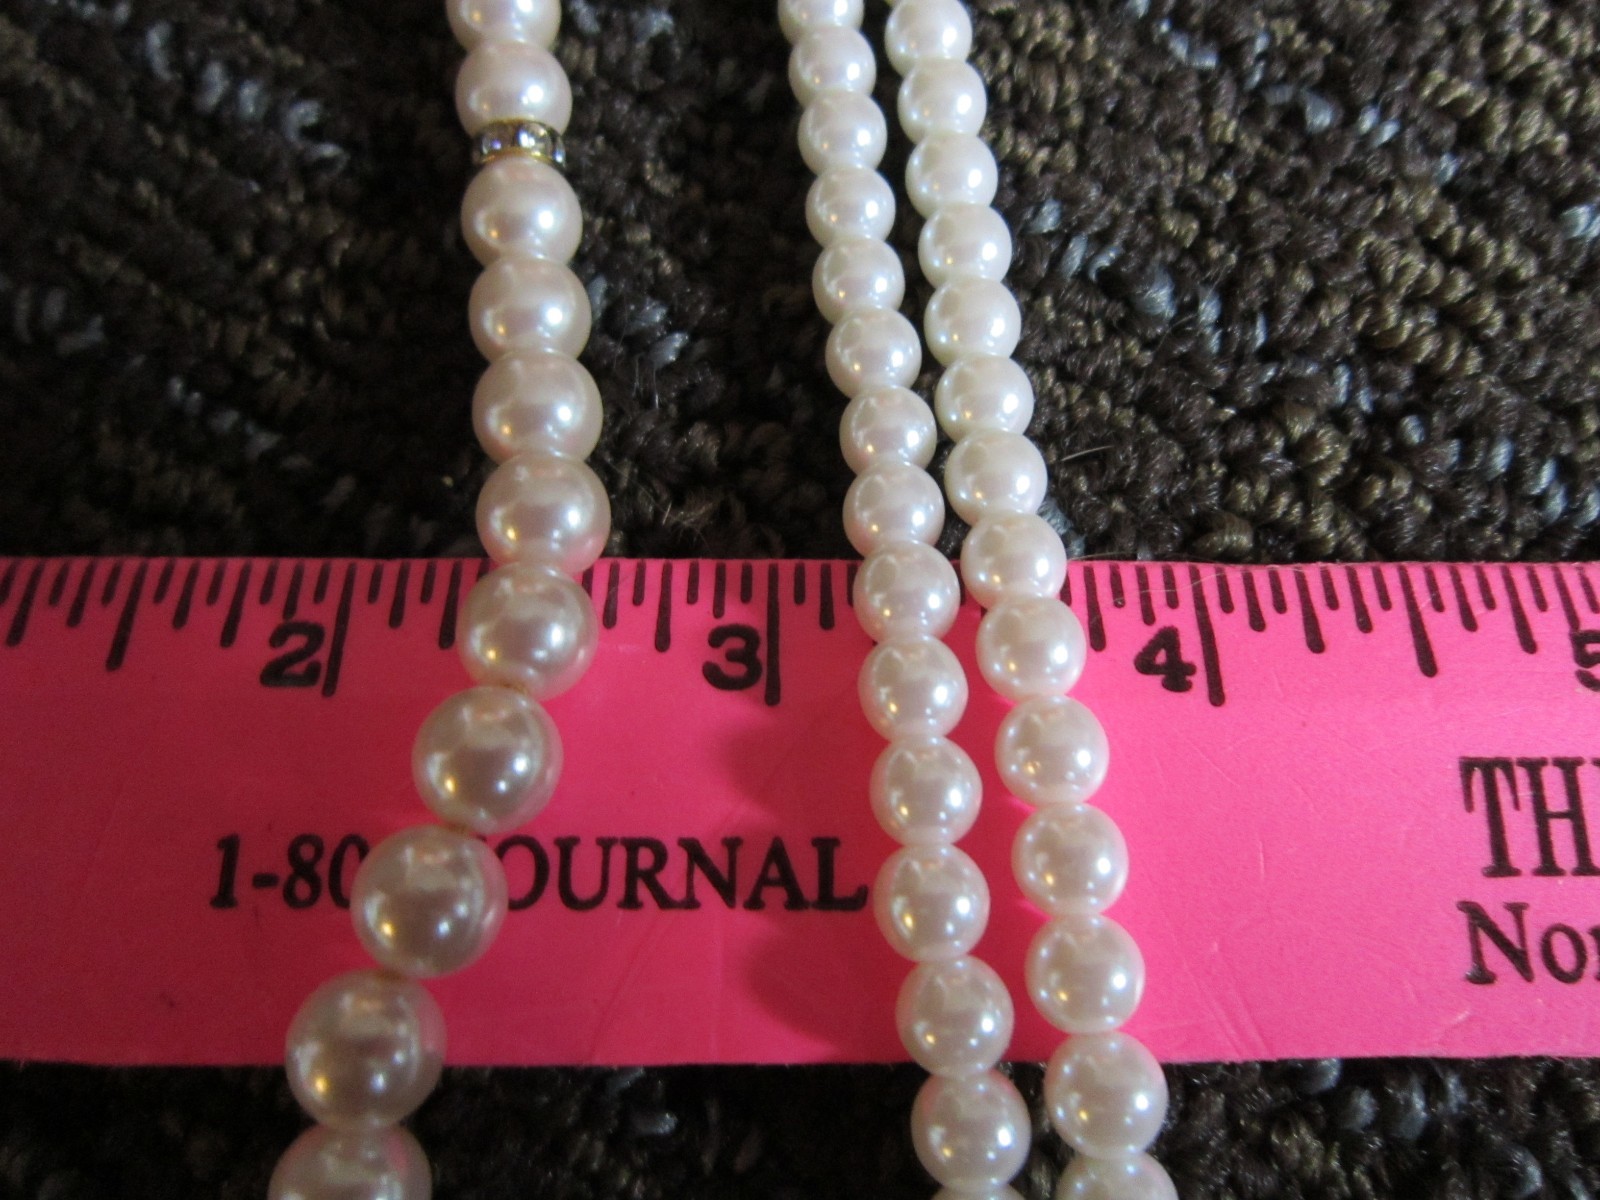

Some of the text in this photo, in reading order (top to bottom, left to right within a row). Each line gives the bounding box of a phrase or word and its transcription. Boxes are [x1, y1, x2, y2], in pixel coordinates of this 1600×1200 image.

[260, 622, 324, 687] 2
[702, 625, 762, 689] 3
[1134, 626, 1196, 692] 4
[1459, 756, 1600, 878] TH
